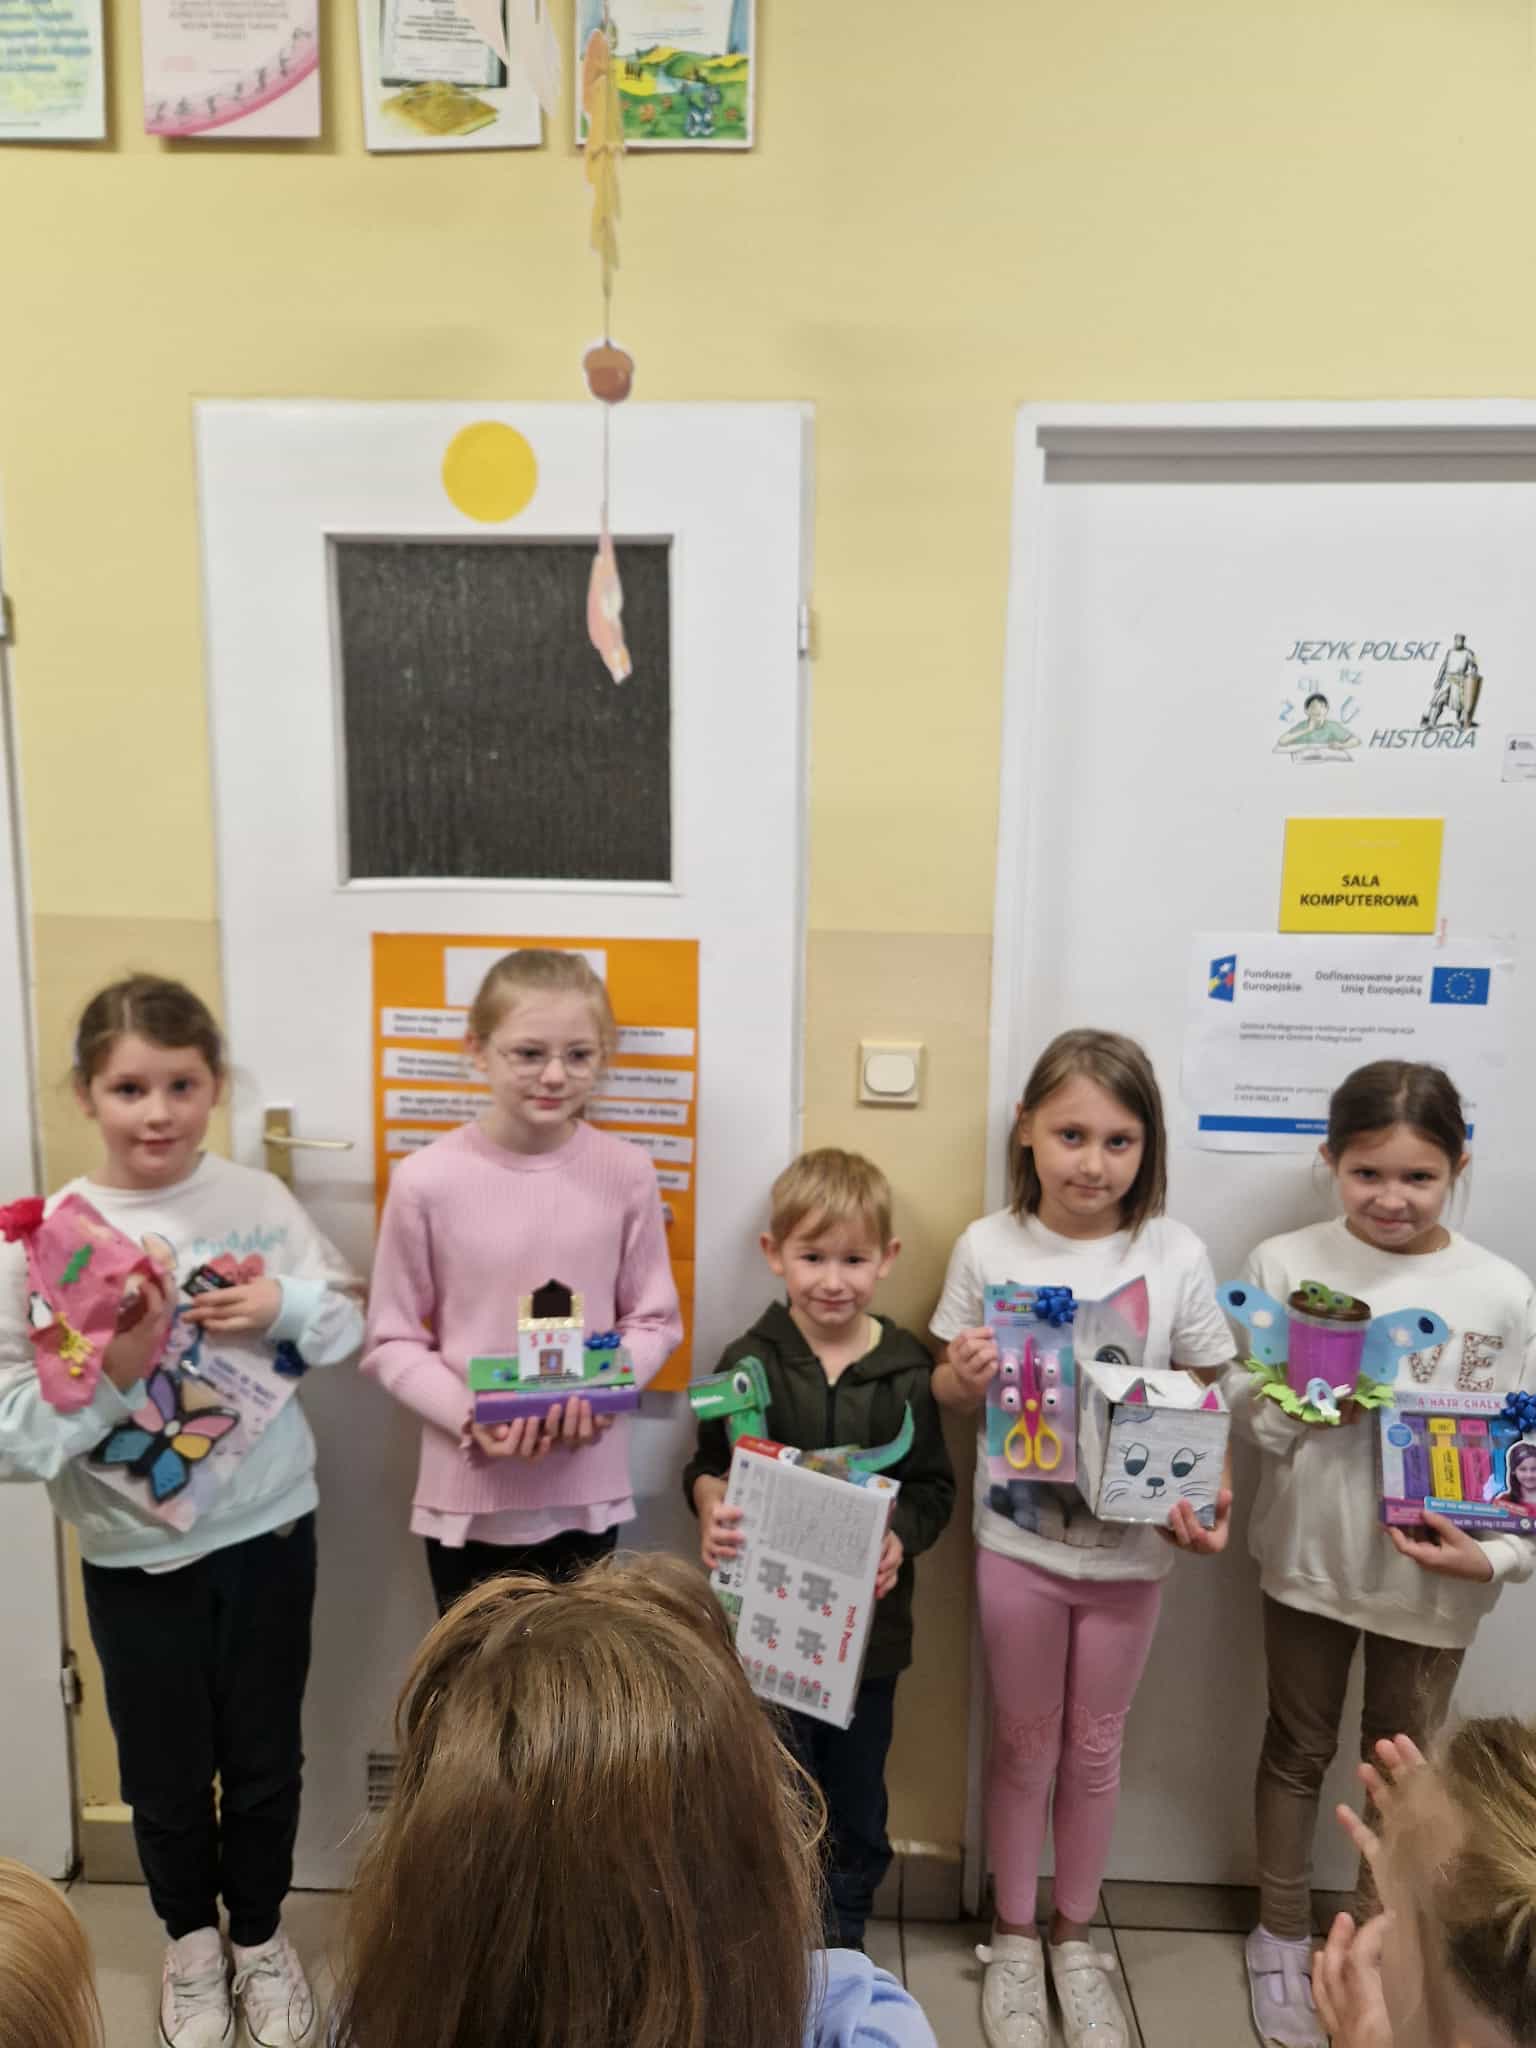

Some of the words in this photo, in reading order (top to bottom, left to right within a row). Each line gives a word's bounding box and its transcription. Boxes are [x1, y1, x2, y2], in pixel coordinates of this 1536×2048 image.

[1286, 641, 1354, 664] JĘZYK
[1359, 641, 1440, 660] POLSKI
[1369, 728, 1477, 749] HISTORIA
[1342, 875, 1380, 887] SALA
[1300, 894, 1419, 907] KOMPUTEROWA
[1243, 969, 1292, 980] Fundusze
[1315, 971, 1393, 982] Dofinansowane
[1395, 975, 1423, 985] przez
[1243, 981, 1302, 993] Europejskie
[1341, 985, 1365, 995] Unię
[1367, 986, 1422, 996] Europejską
[1408, 1331, 1504, 1392] VE
